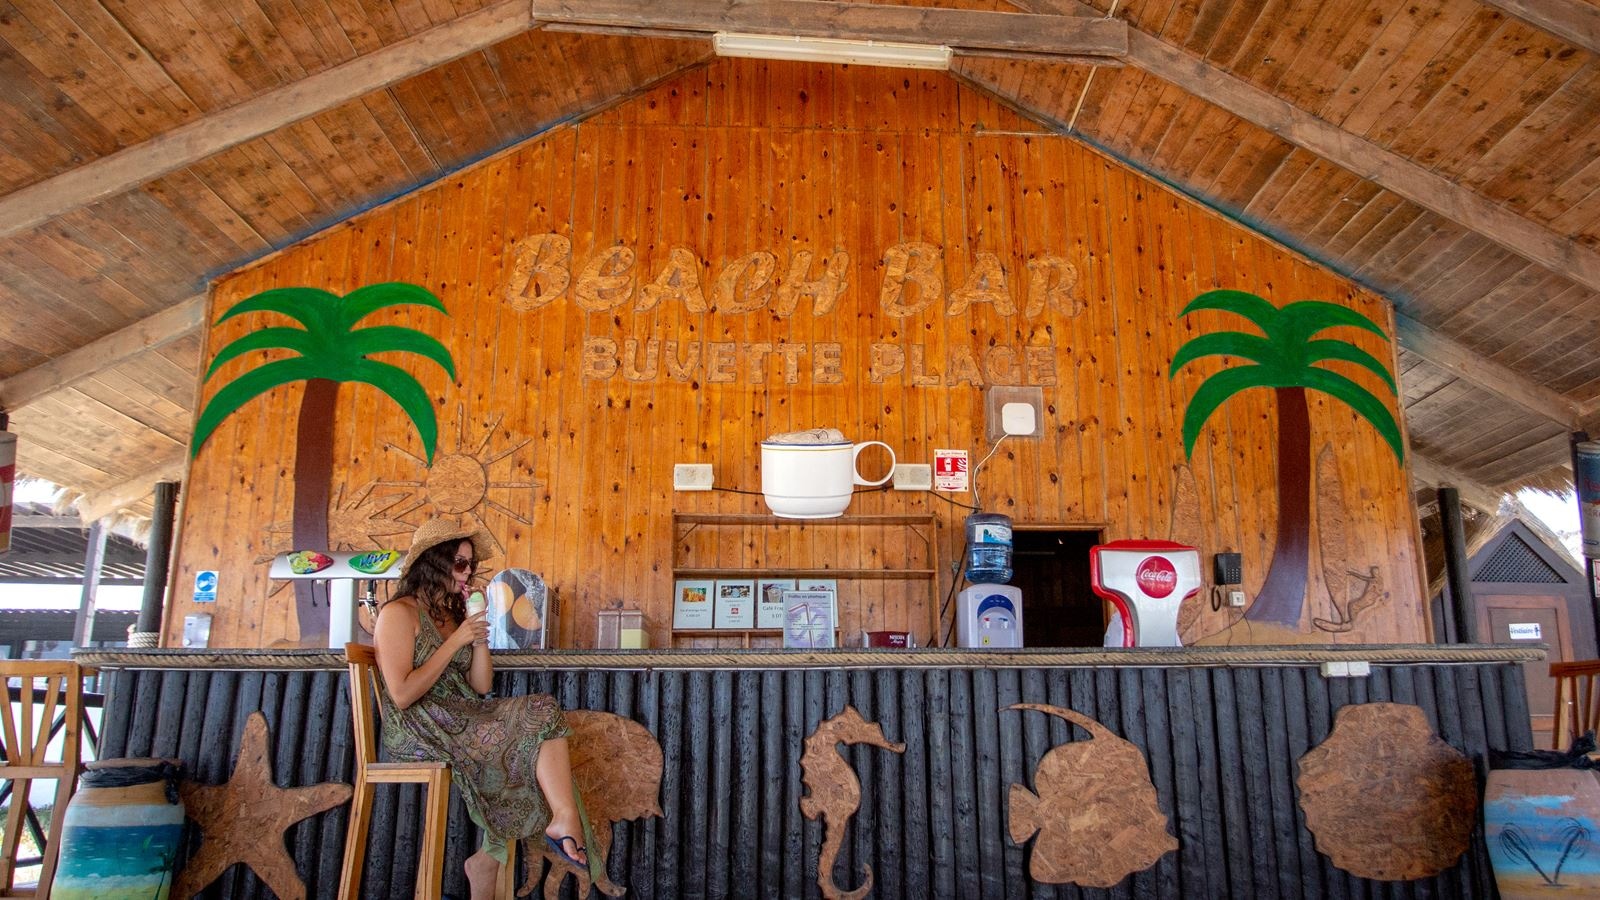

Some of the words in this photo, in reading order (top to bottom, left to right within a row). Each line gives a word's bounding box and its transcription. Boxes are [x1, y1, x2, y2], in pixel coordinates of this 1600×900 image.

[881, 241, 1085, 318] BAR
[582, 337, 843, 385] BUVETTE
[870, 342, 1057, 386] PLACE
[360, 552, 391, 566] VIVA
